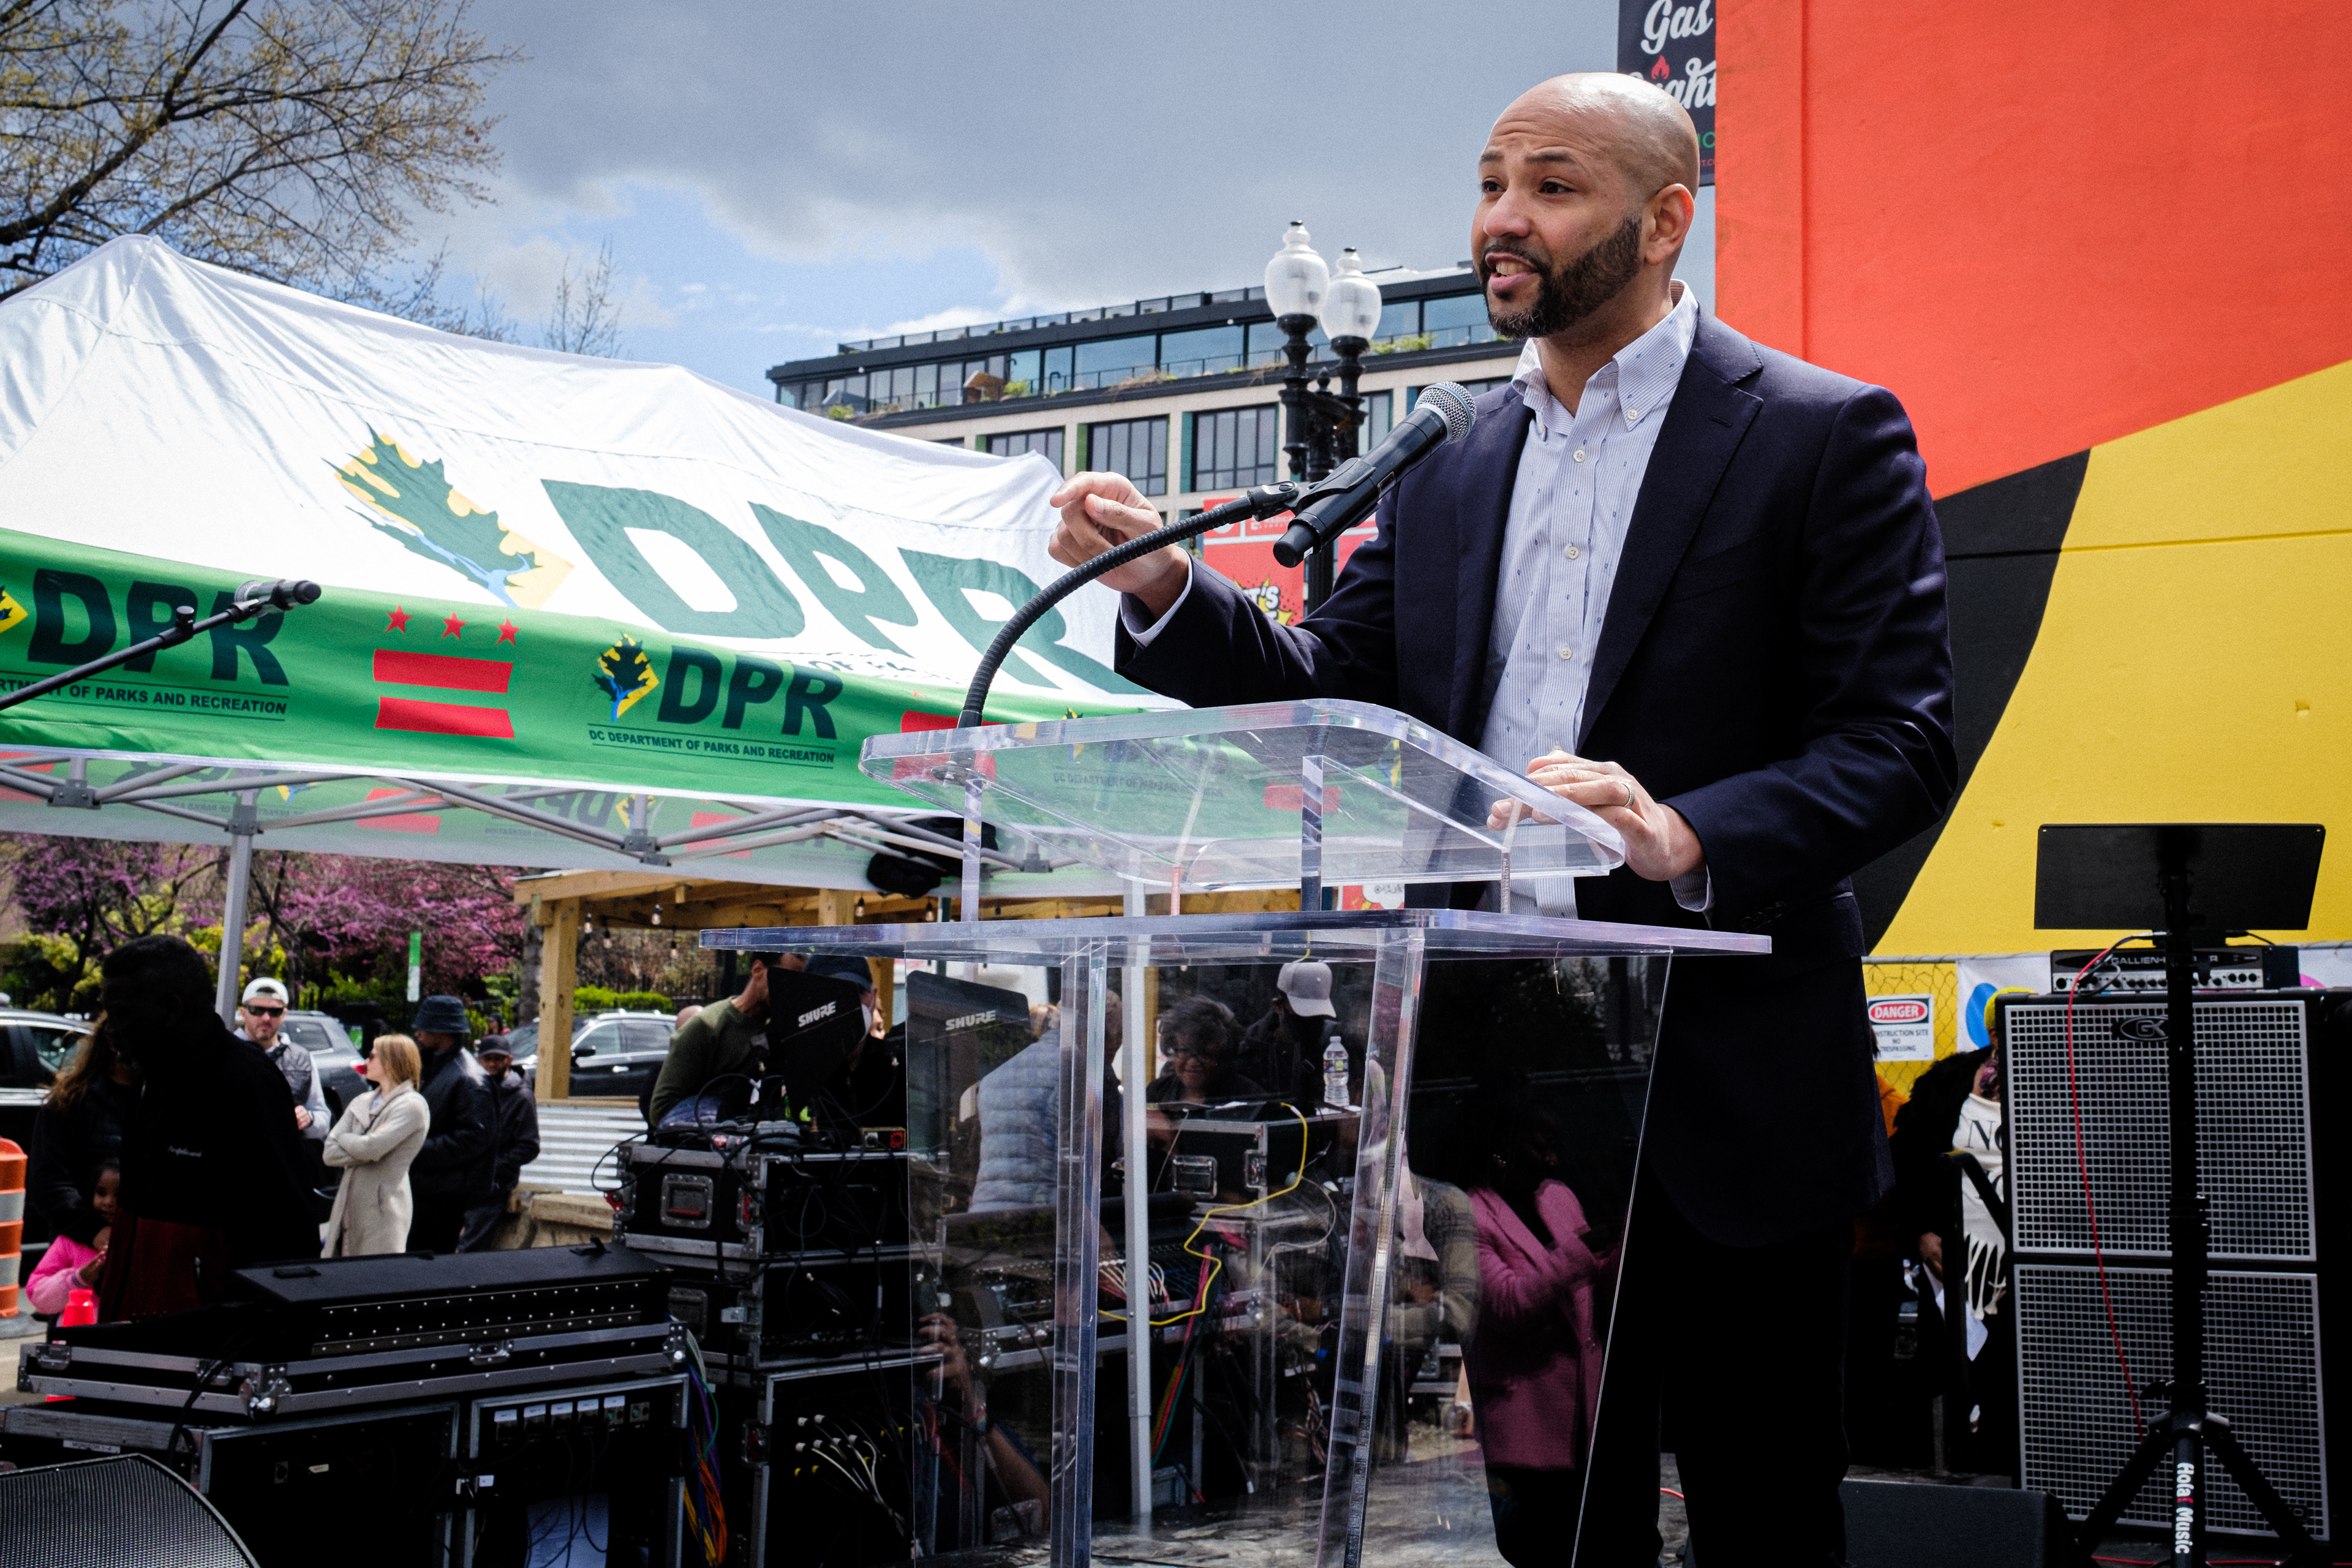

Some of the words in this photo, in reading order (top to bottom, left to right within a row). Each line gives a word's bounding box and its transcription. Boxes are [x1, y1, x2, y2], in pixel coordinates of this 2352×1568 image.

[1640, 0, 1714, 55] Gas
[540, 478, 1159, 694] DPR
[1244, 586, 1280, 609] T'S
[28, 568, 290, 687] DPR
[69, 684, 90, 697] OF
[96, 687, 148, 703] PARKS
[153, 692, 185, 706] AND
[190, 695, 287, 715] RECREATION
[657, 645, 844, 740] DPR
[589, 729, 605, 741] DC
[608, 732, 683, 749] DEPARTMENT
[686, 739, 701, 750] OF
[704, 741, 740, 755] PARKS
[743, 745, 766, 757] AND
[768, 748, 834, 763] RECREATION
[798, 1001, 837, 1027] SHURE
[945, 1010, 997, 1031] SHURE
[1875, 1005, 1919, 1018] DANGER
[2175, 1507, 2193, 1554] Music
